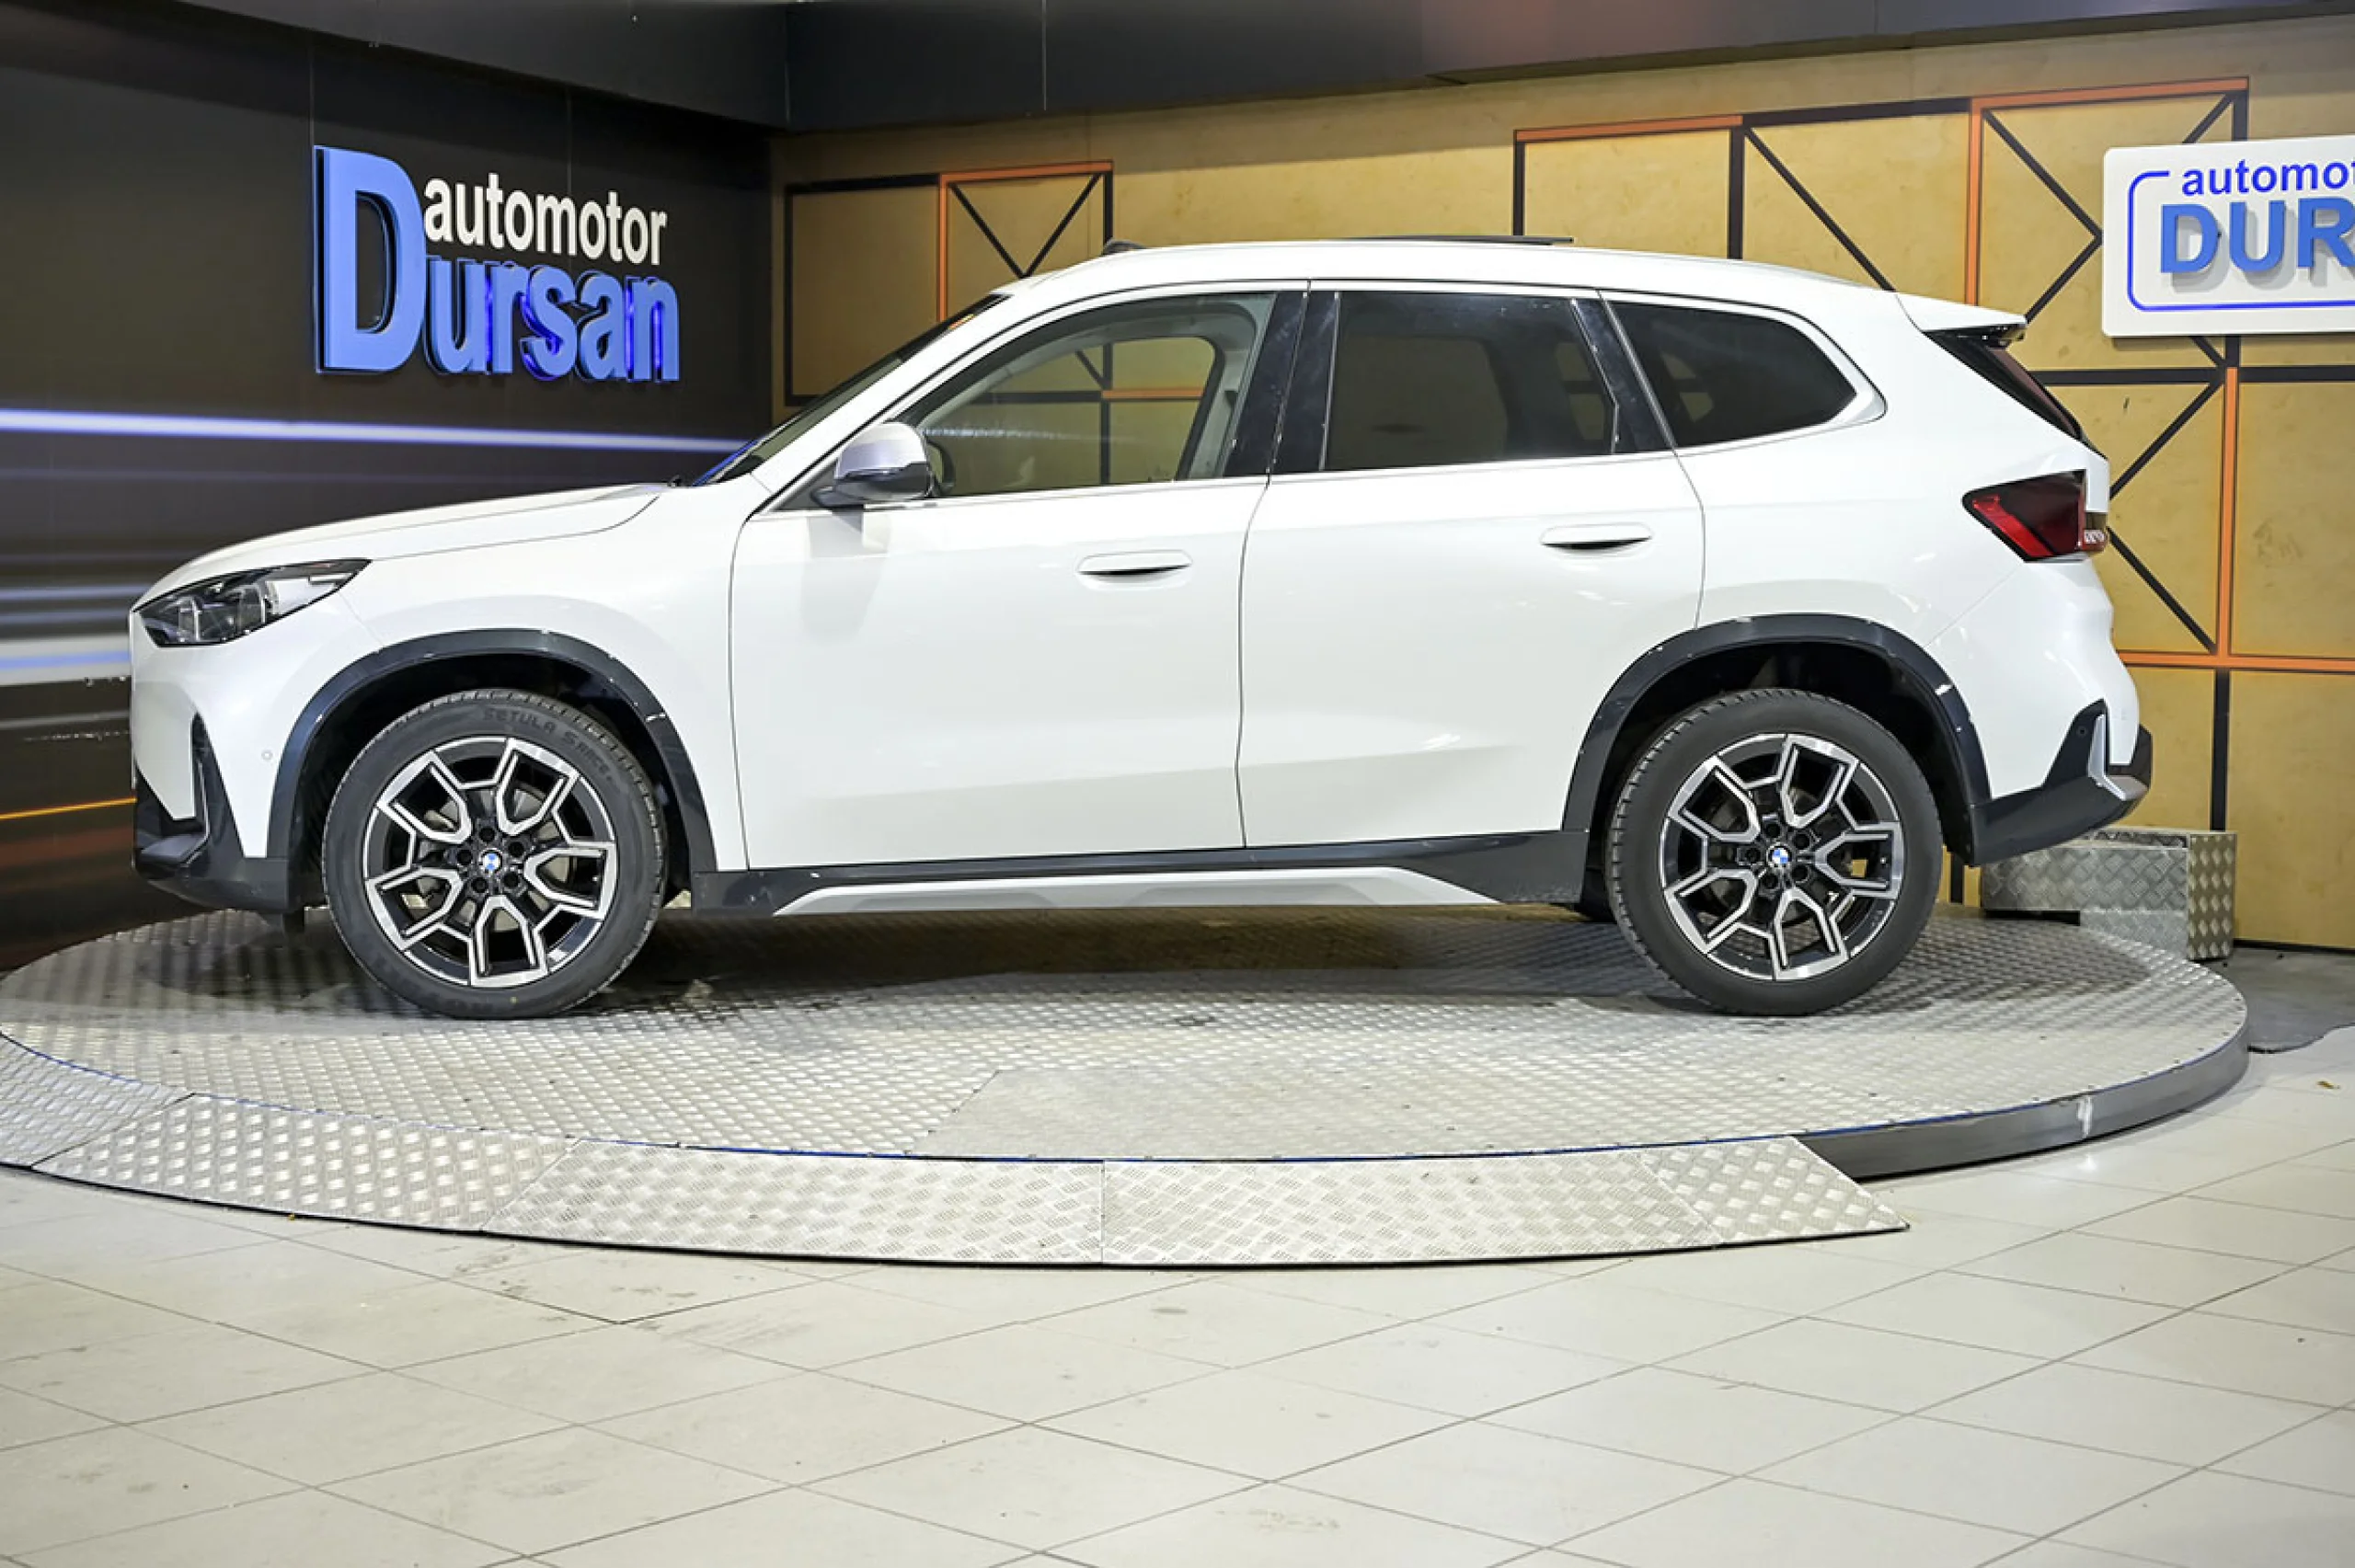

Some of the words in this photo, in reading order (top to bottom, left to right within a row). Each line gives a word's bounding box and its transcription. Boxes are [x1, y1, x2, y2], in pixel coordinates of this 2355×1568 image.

[423, 171, 668, 266] automotor
[2181, 159, 2355, 197] automo
[314, 145, 680, 383] Dursan
